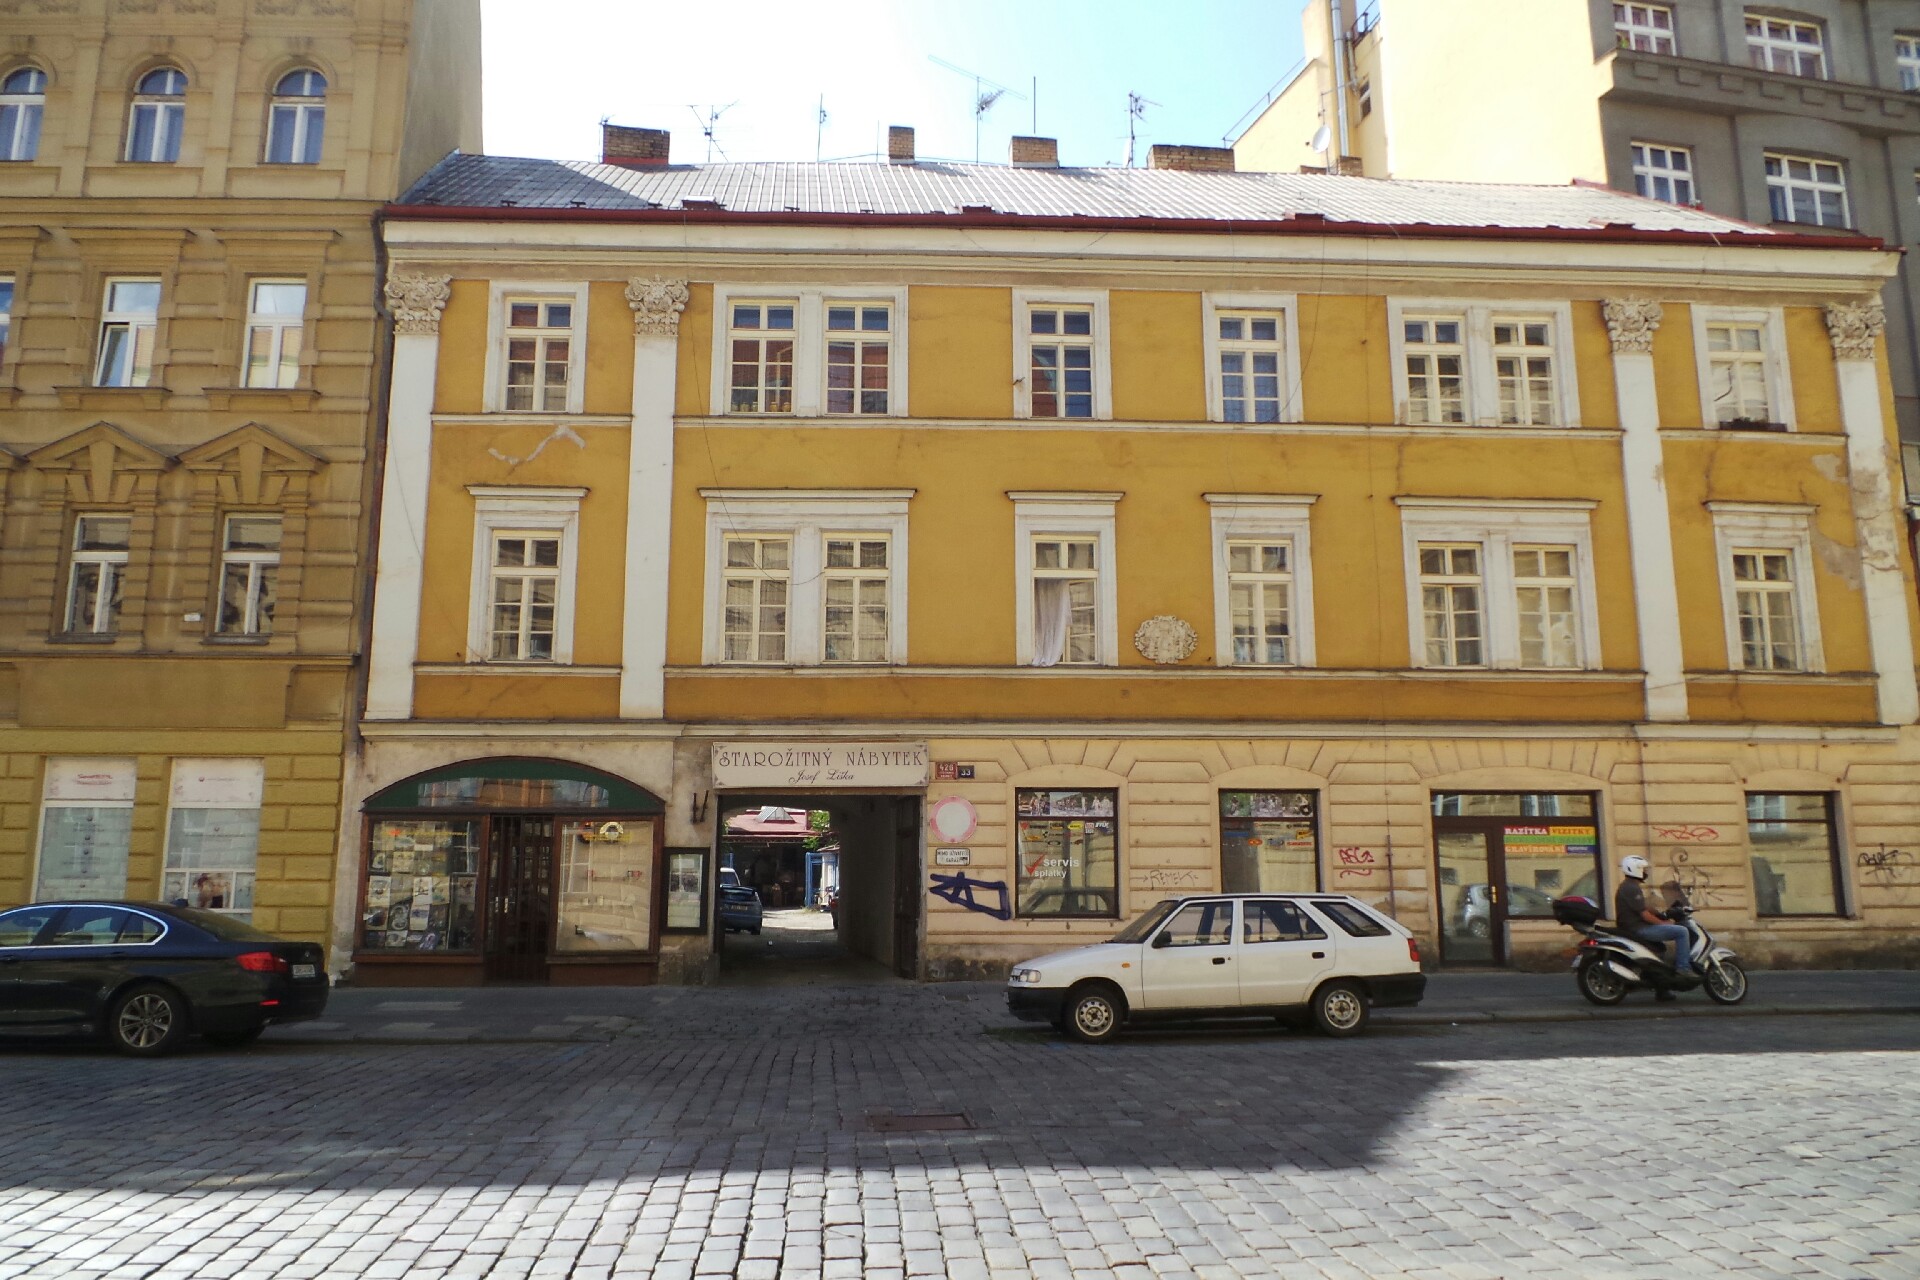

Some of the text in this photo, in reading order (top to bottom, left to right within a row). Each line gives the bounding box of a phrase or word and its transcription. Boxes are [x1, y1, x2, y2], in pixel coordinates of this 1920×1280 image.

[719, 748, 923, 767] STAROŽITNÝ NÁBYTEK
[789, 769, 855, 784] Josef Liška
[1504, 827, 1548, 835] RAZÍTKA
[1043, 857, 1080, 867] servis
[1034, 868, 1067, 878] splatky
